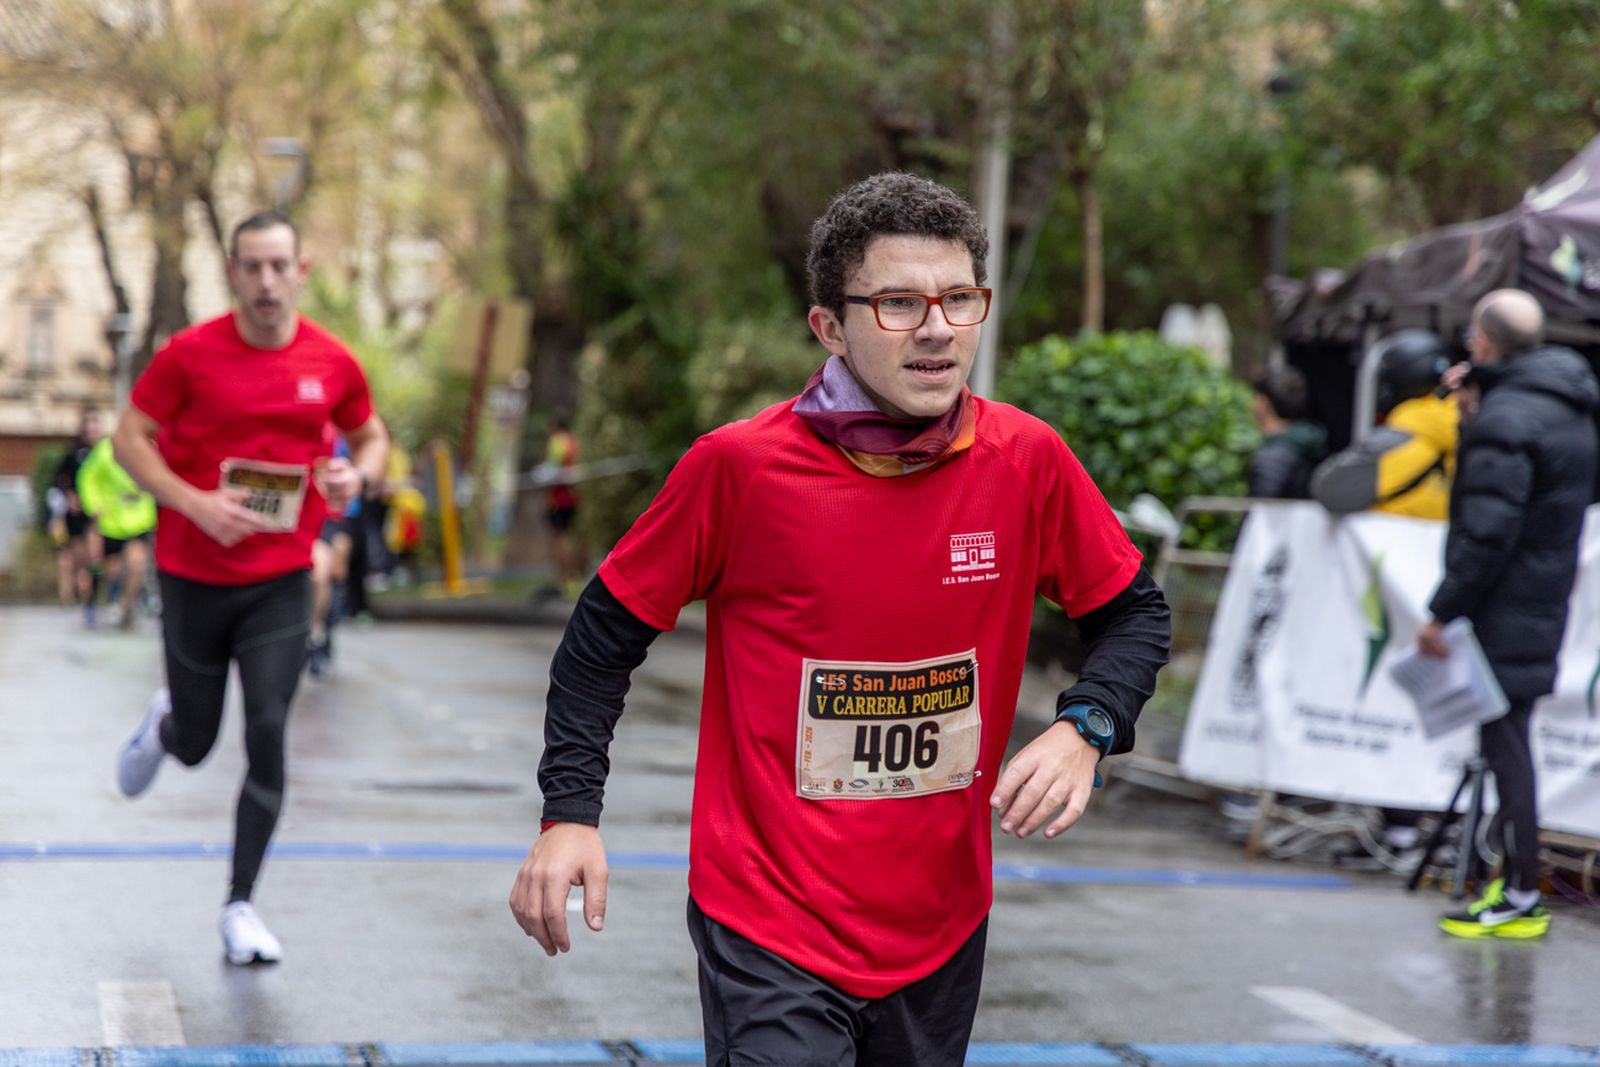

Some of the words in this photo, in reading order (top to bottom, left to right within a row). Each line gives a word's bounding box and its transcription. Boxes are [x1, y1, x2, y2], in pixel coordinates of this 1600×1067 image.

[970, 574, 985, 582] Juan
[822, 673, 847, 691] IES
[853, 673, 885, 692] San
[889, 674, 926, 692] Juan
[929, 666, 967, 687] Bosco
[816, 694, 828, 715] V
[833, 694, 907, 716] CARRERA
[912, 685, 970, 714] POPULAR
[853, 720, 940, 773] 406
